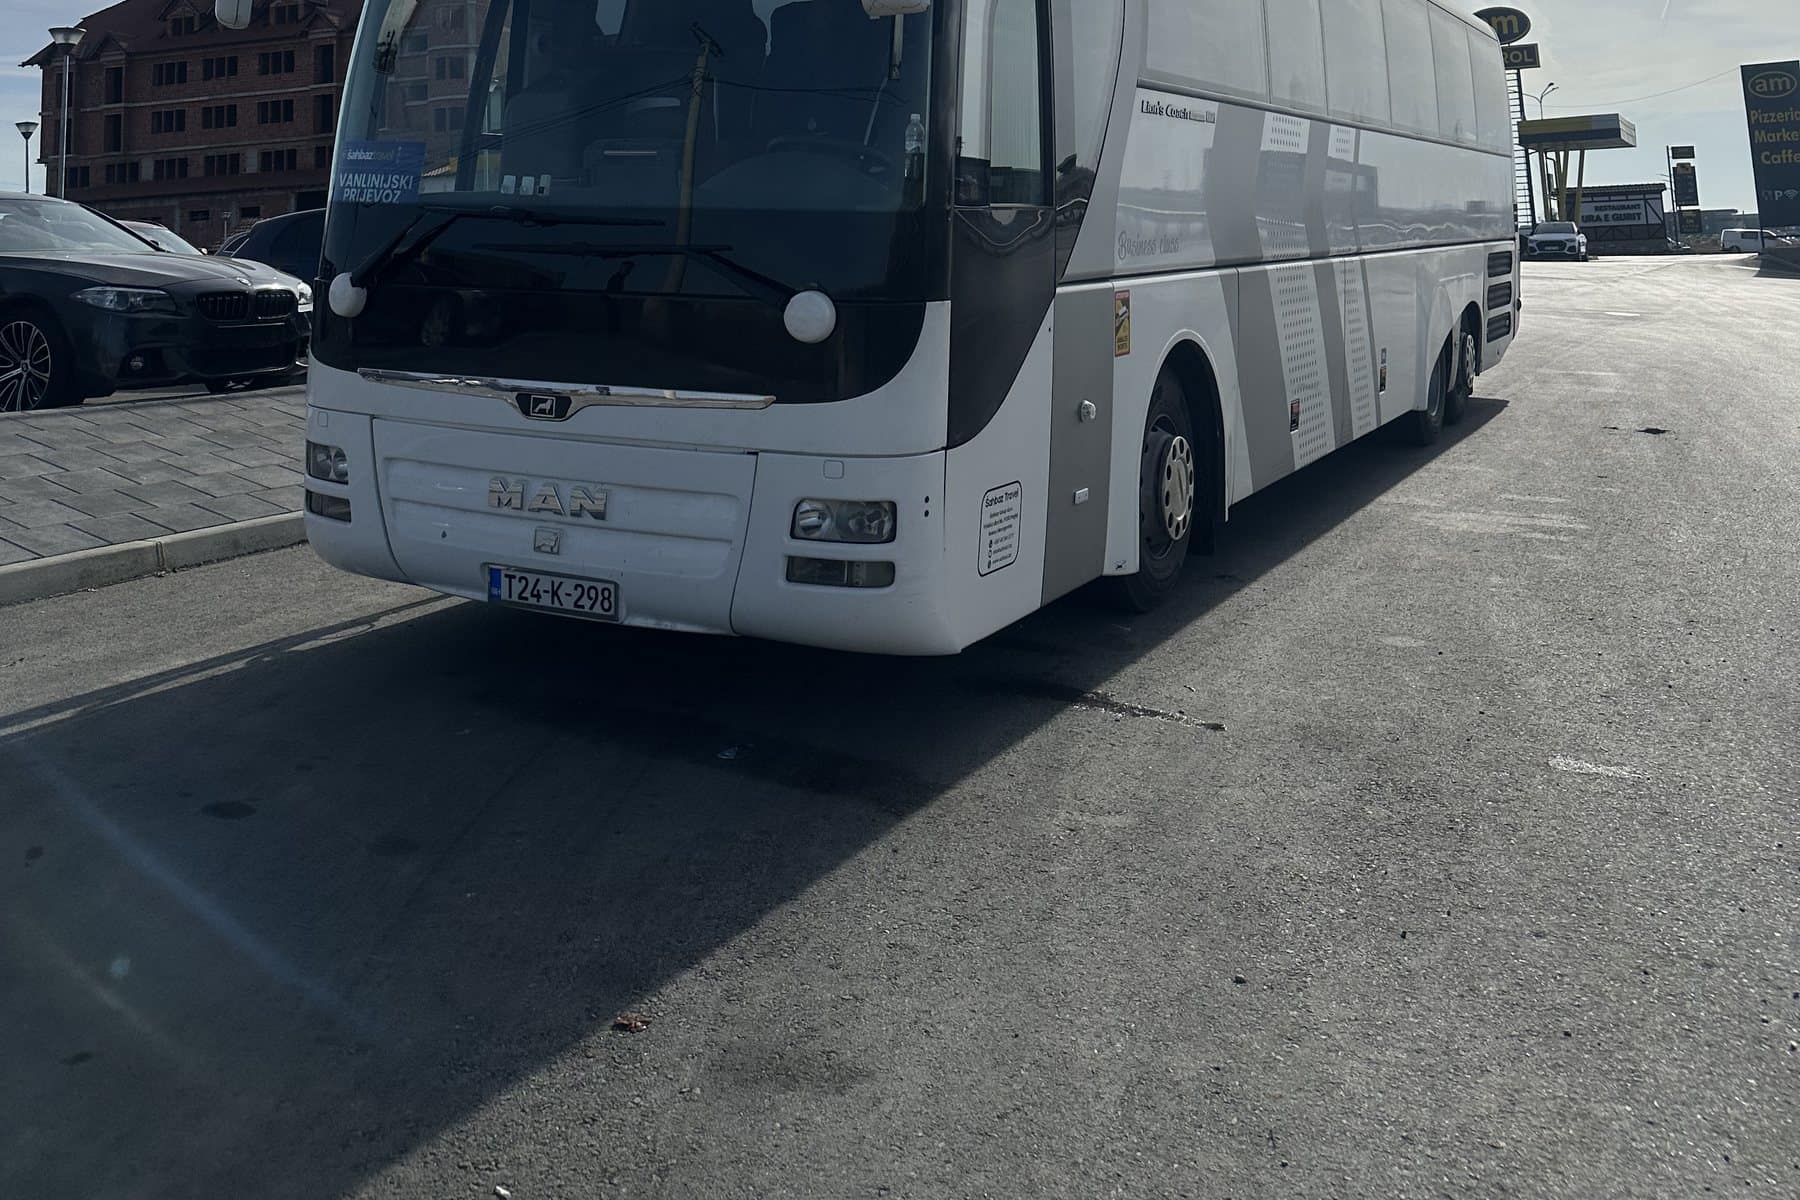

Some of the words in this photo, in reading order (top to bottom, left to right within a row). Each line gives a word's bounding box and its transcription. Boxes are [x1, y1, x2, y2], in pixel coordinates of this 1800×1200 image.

[1755, 76, 1791, 92] am
[1754, 128, 1800, 143] Marke
[339, 173, 414, 189] VANLINIJSKI
[343, 188, 402, 203] PRIJEVOZ
[488, 478, 608, 520] MAN
[504, 573, 612, 613] T24-K-298
